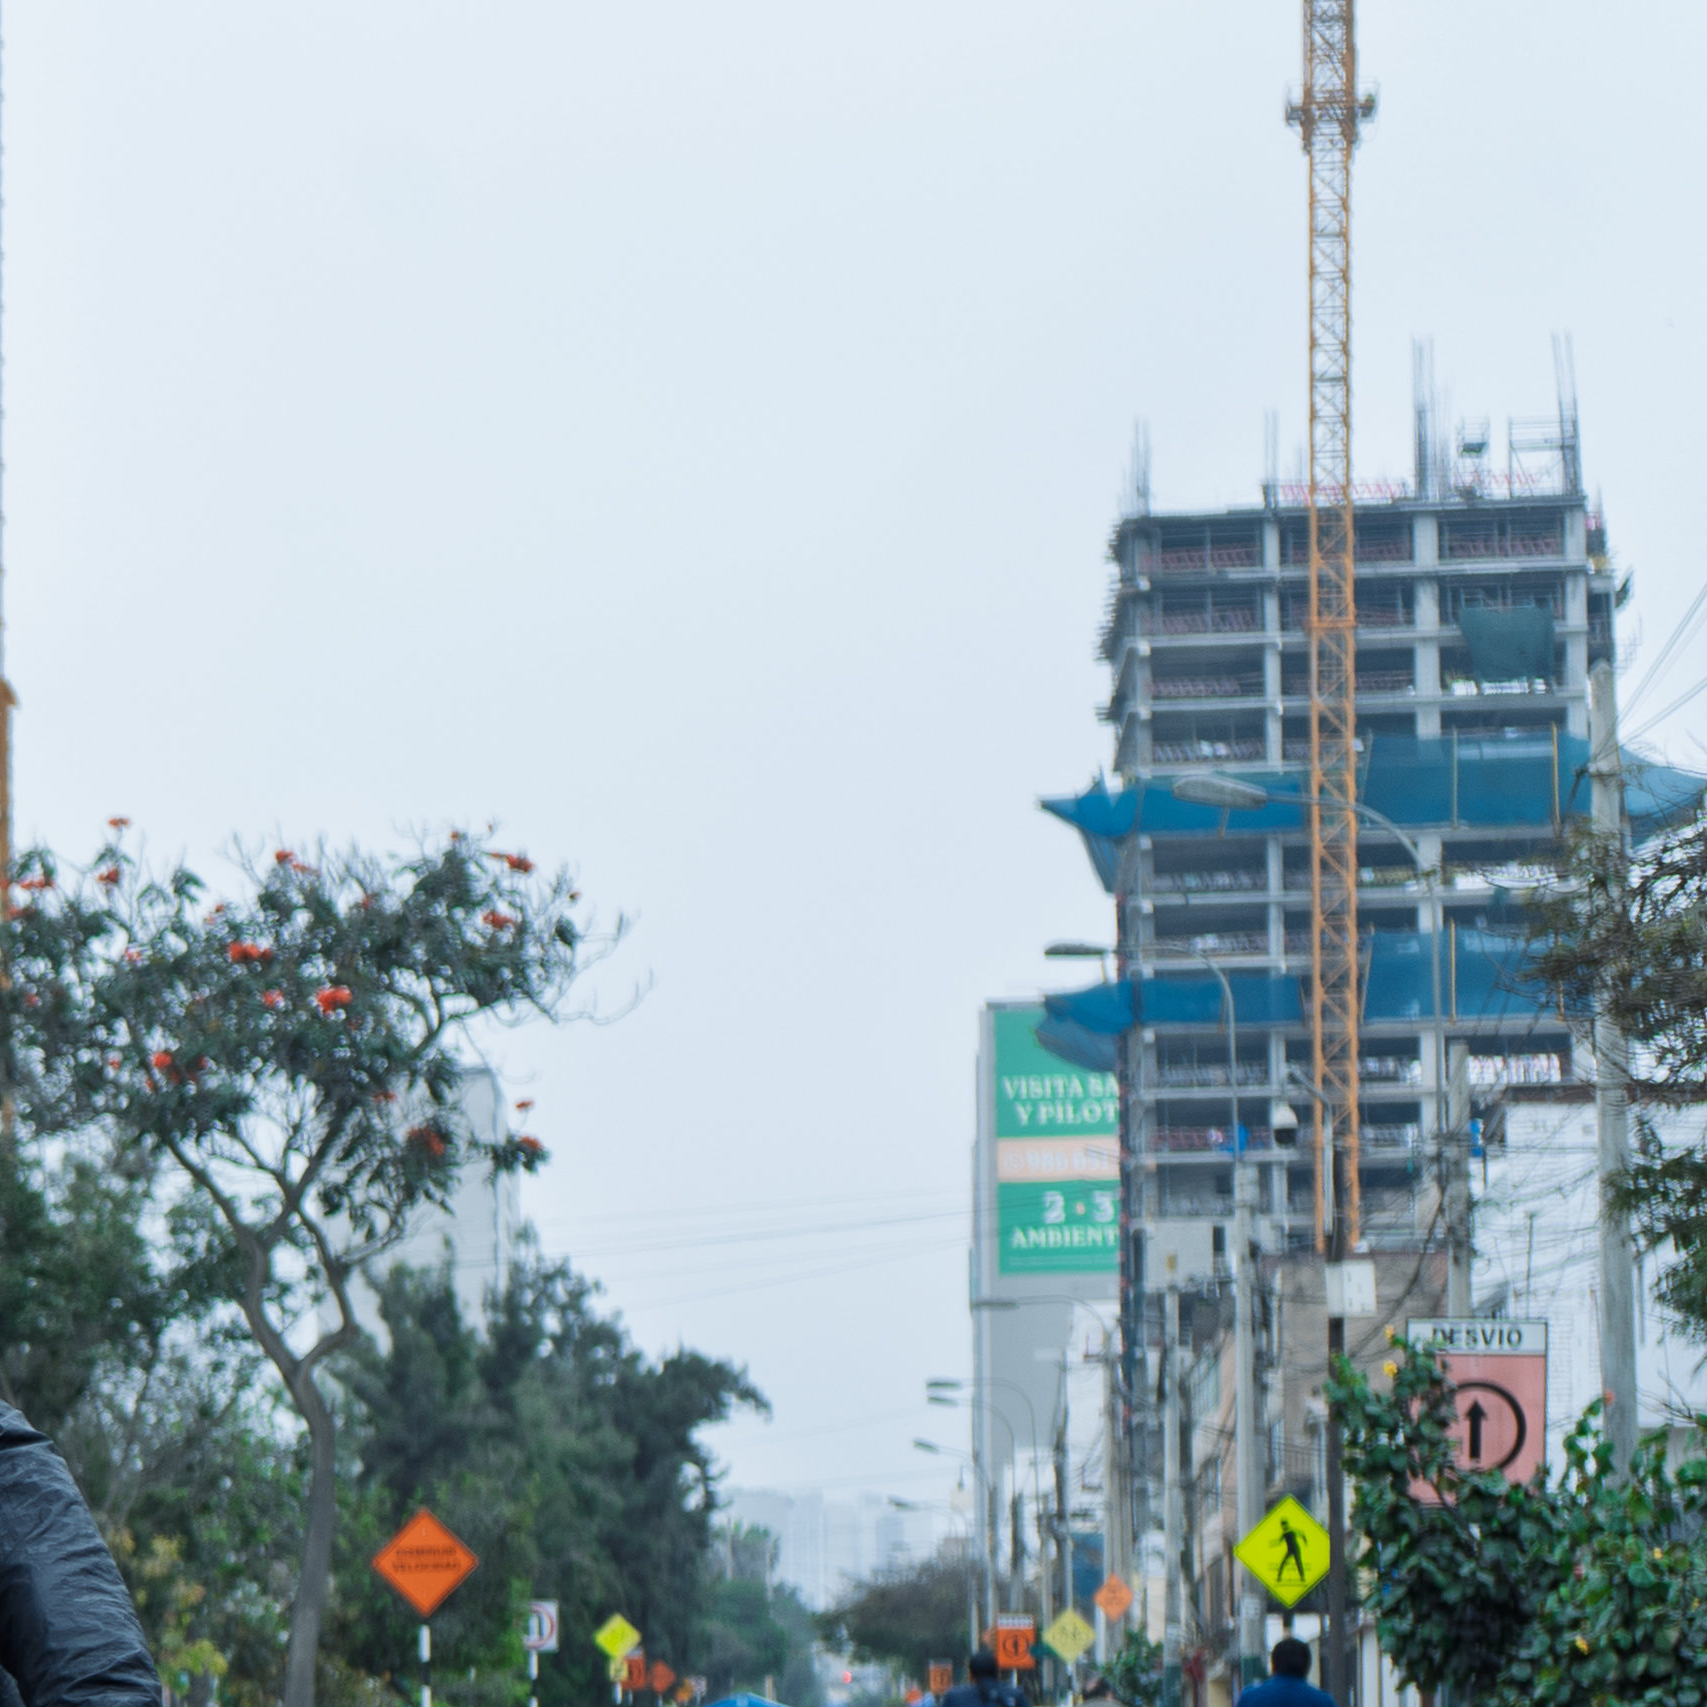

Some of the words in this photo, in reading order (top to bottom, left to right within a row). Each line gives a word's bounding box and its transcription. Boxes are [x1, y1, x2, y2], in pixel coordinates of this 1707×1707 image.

[1003, 1073, 1084, 1099] VISITA
[1015, 1102, 1032, 1125] Y
[1011, 1226, 1119, 1248] AMBIENT
